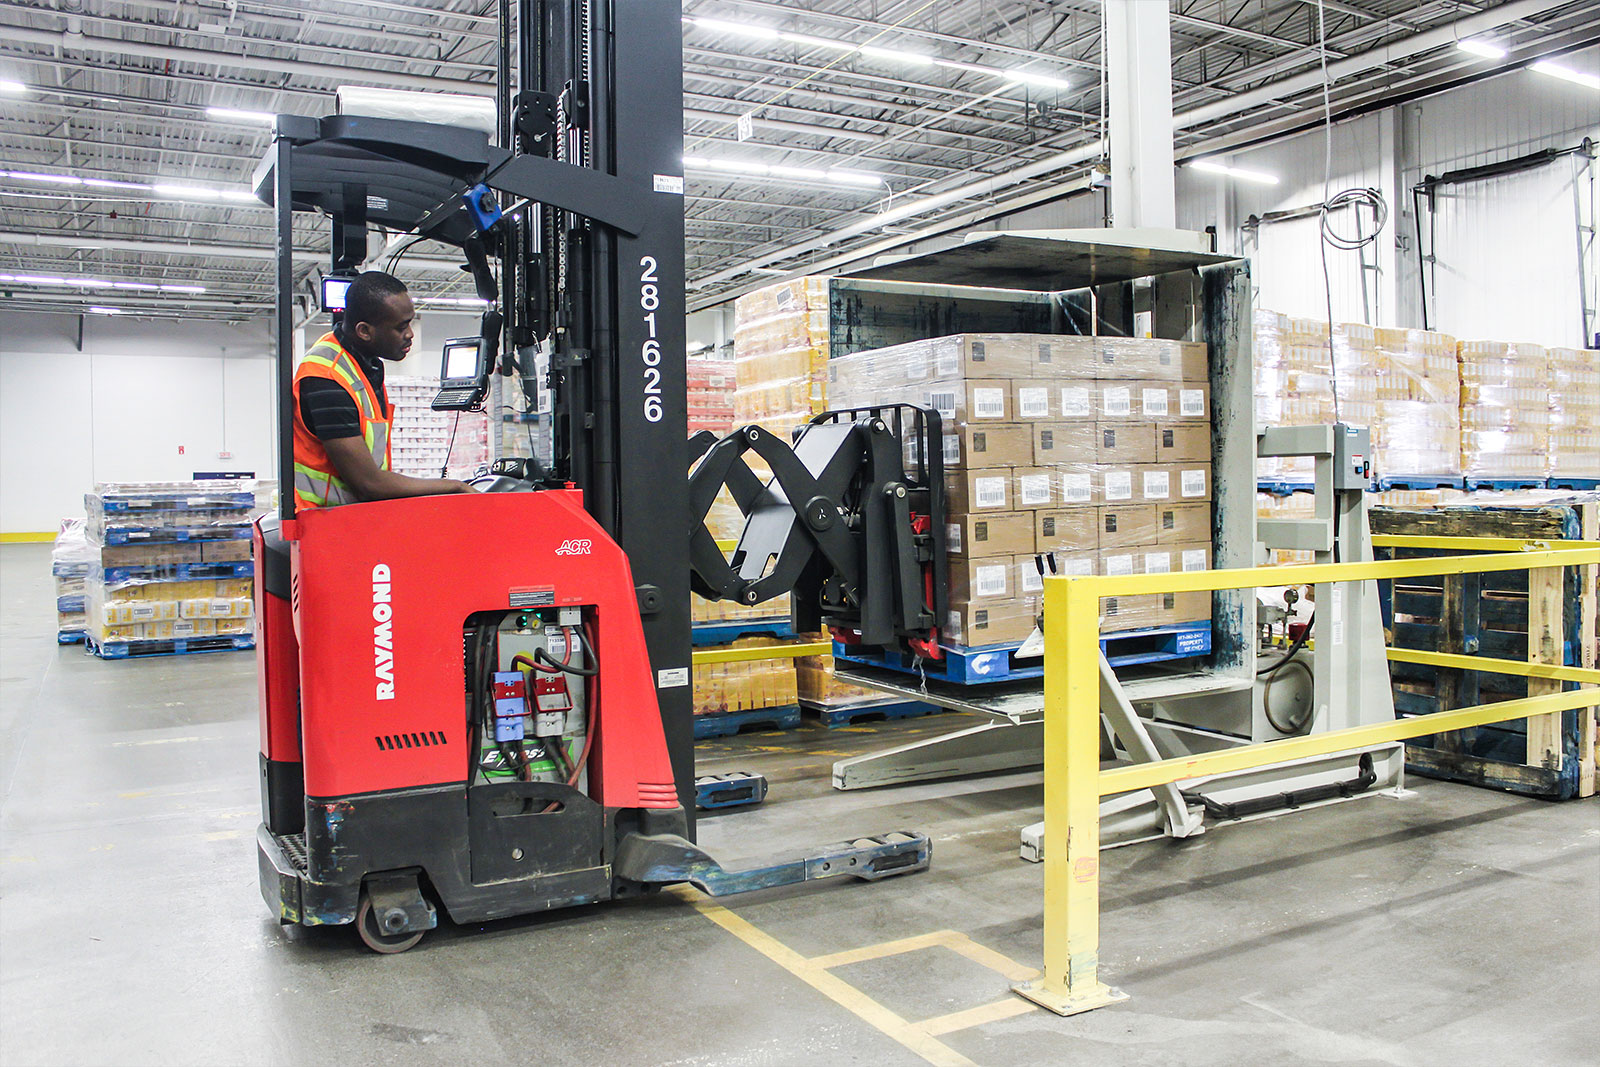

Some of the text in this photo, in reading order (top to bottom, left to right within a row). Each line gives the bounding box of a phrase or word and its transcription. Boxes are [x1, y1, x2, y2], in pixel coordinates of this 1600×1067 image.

[640, 256, 663, 422] 281626
[555, 539, 592, 555] ACR
[372, 564, 395, 700] RAYMOND
[1179, 639, 1203, 647] PROPERTY
